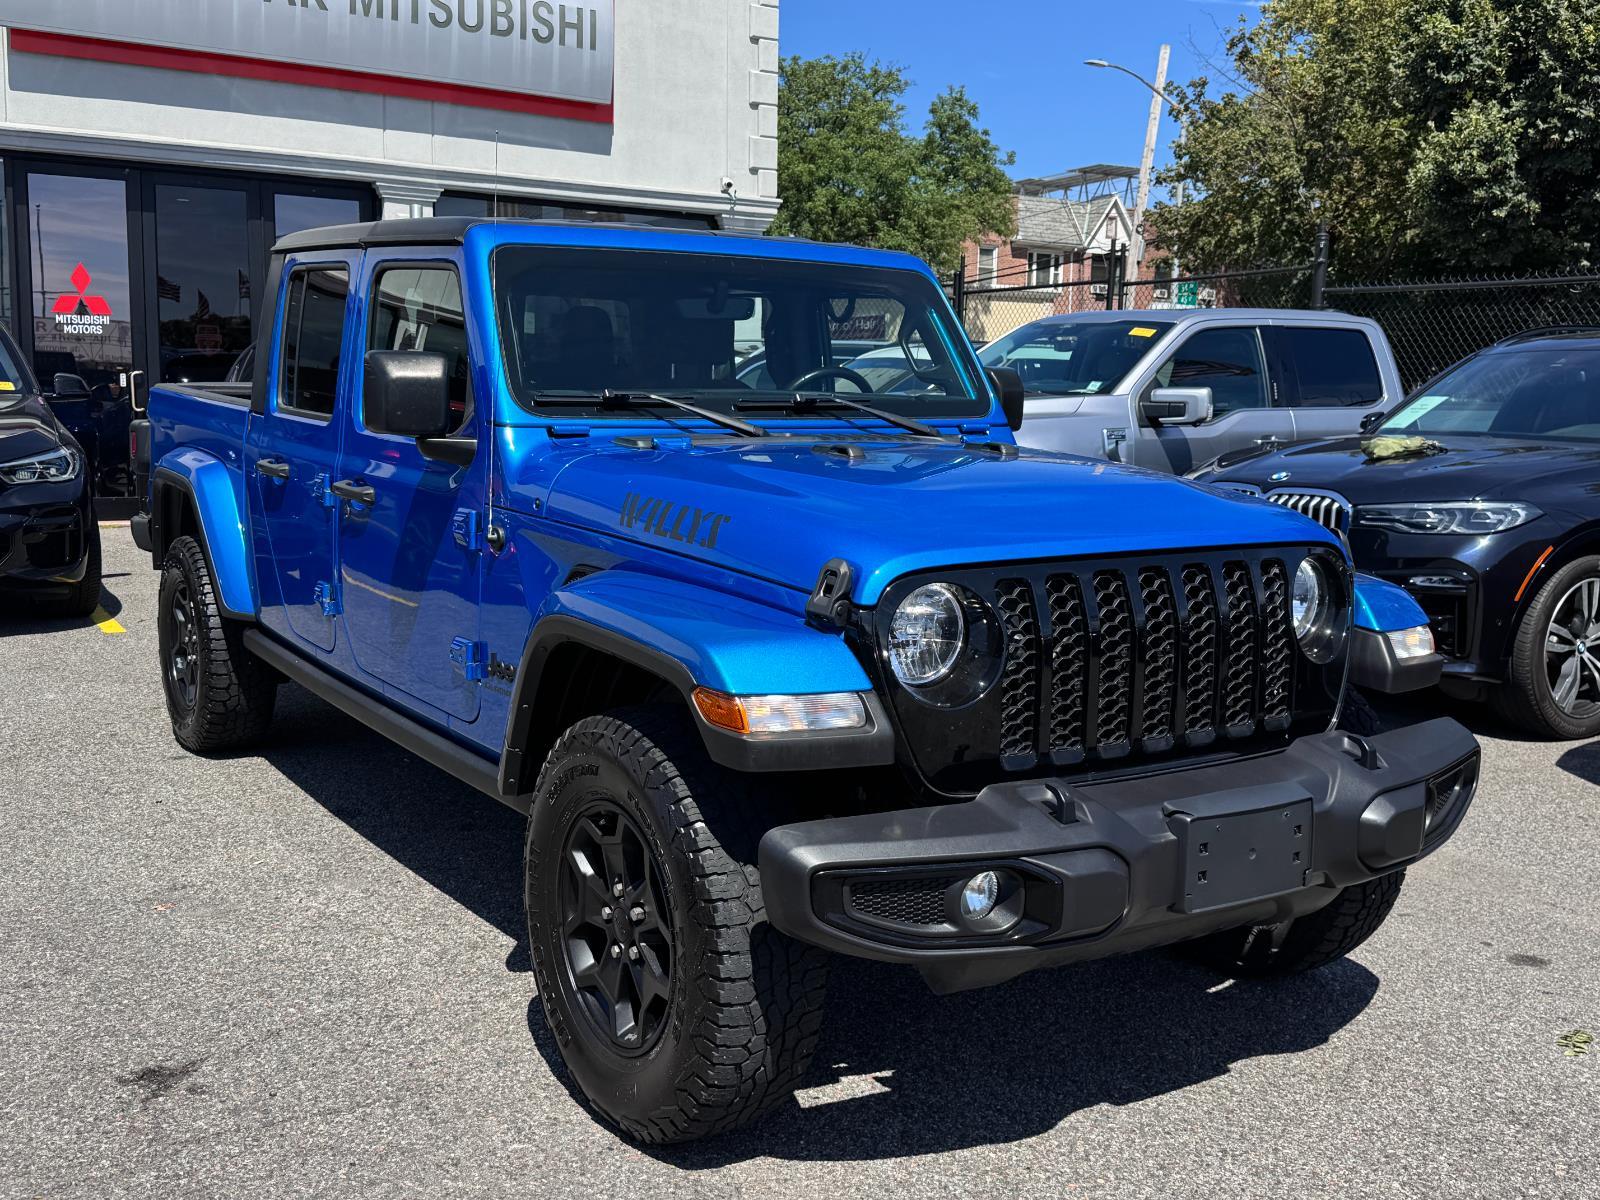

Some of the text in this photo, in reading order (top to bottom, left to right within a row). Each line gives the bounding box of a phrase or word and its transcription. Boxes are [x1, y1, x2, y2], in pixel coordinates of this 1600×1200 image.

[55, 314, 110, 325] MITSUBISHI
[63, 324, 103, 335] MOTORS
[619, 490, 732, 549] WILLYS
